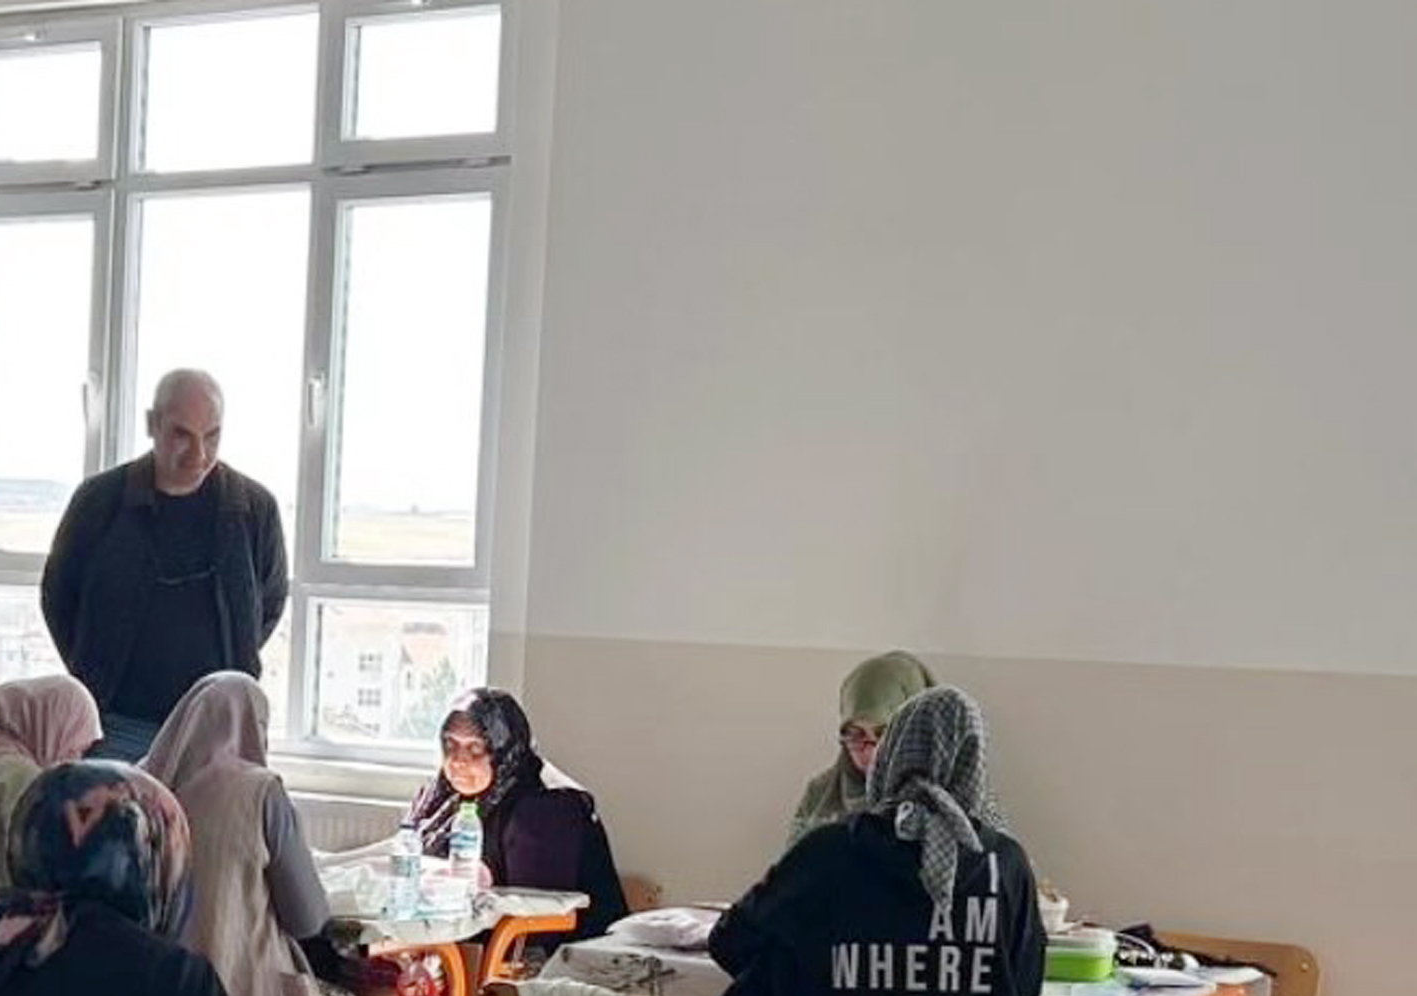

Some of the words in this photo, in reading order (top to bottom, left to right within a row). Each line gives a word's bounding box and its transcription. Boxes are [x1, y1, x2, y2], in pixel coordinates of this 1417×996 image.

[989, 851, 999, 893] I
[928, 896, 998, 943] AM
[831, 943, 996, 994] WHERE
